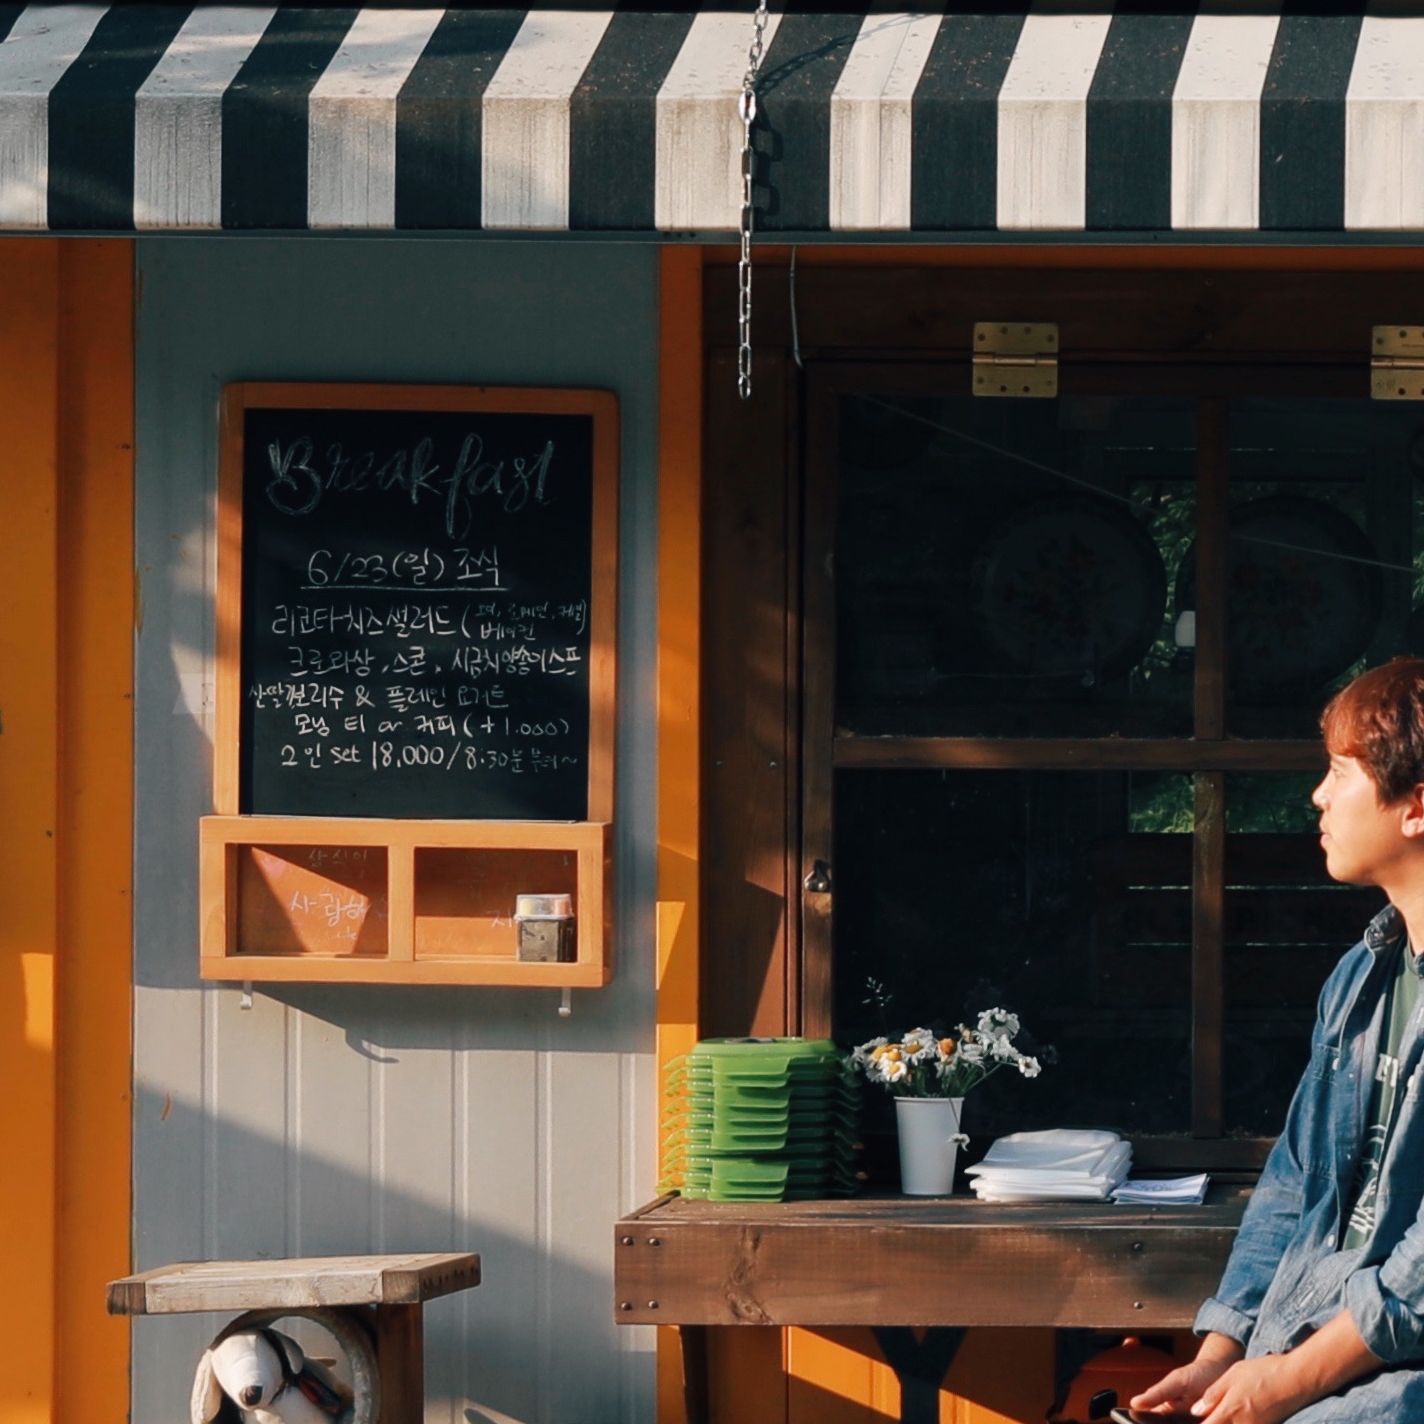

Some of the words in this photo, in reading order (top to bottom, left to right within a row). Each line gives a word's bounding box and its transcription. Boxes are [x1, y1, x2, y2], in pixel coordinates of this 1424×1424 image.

[265, 430, 557, 541] Breakfast
[453, 545, 500, 587] 조식
[355, 684, 376, 709] &
[294, 713, 331, 737] 모닝
[344, 713, 366, 733] 티
[378, 720, 403, 733] or
